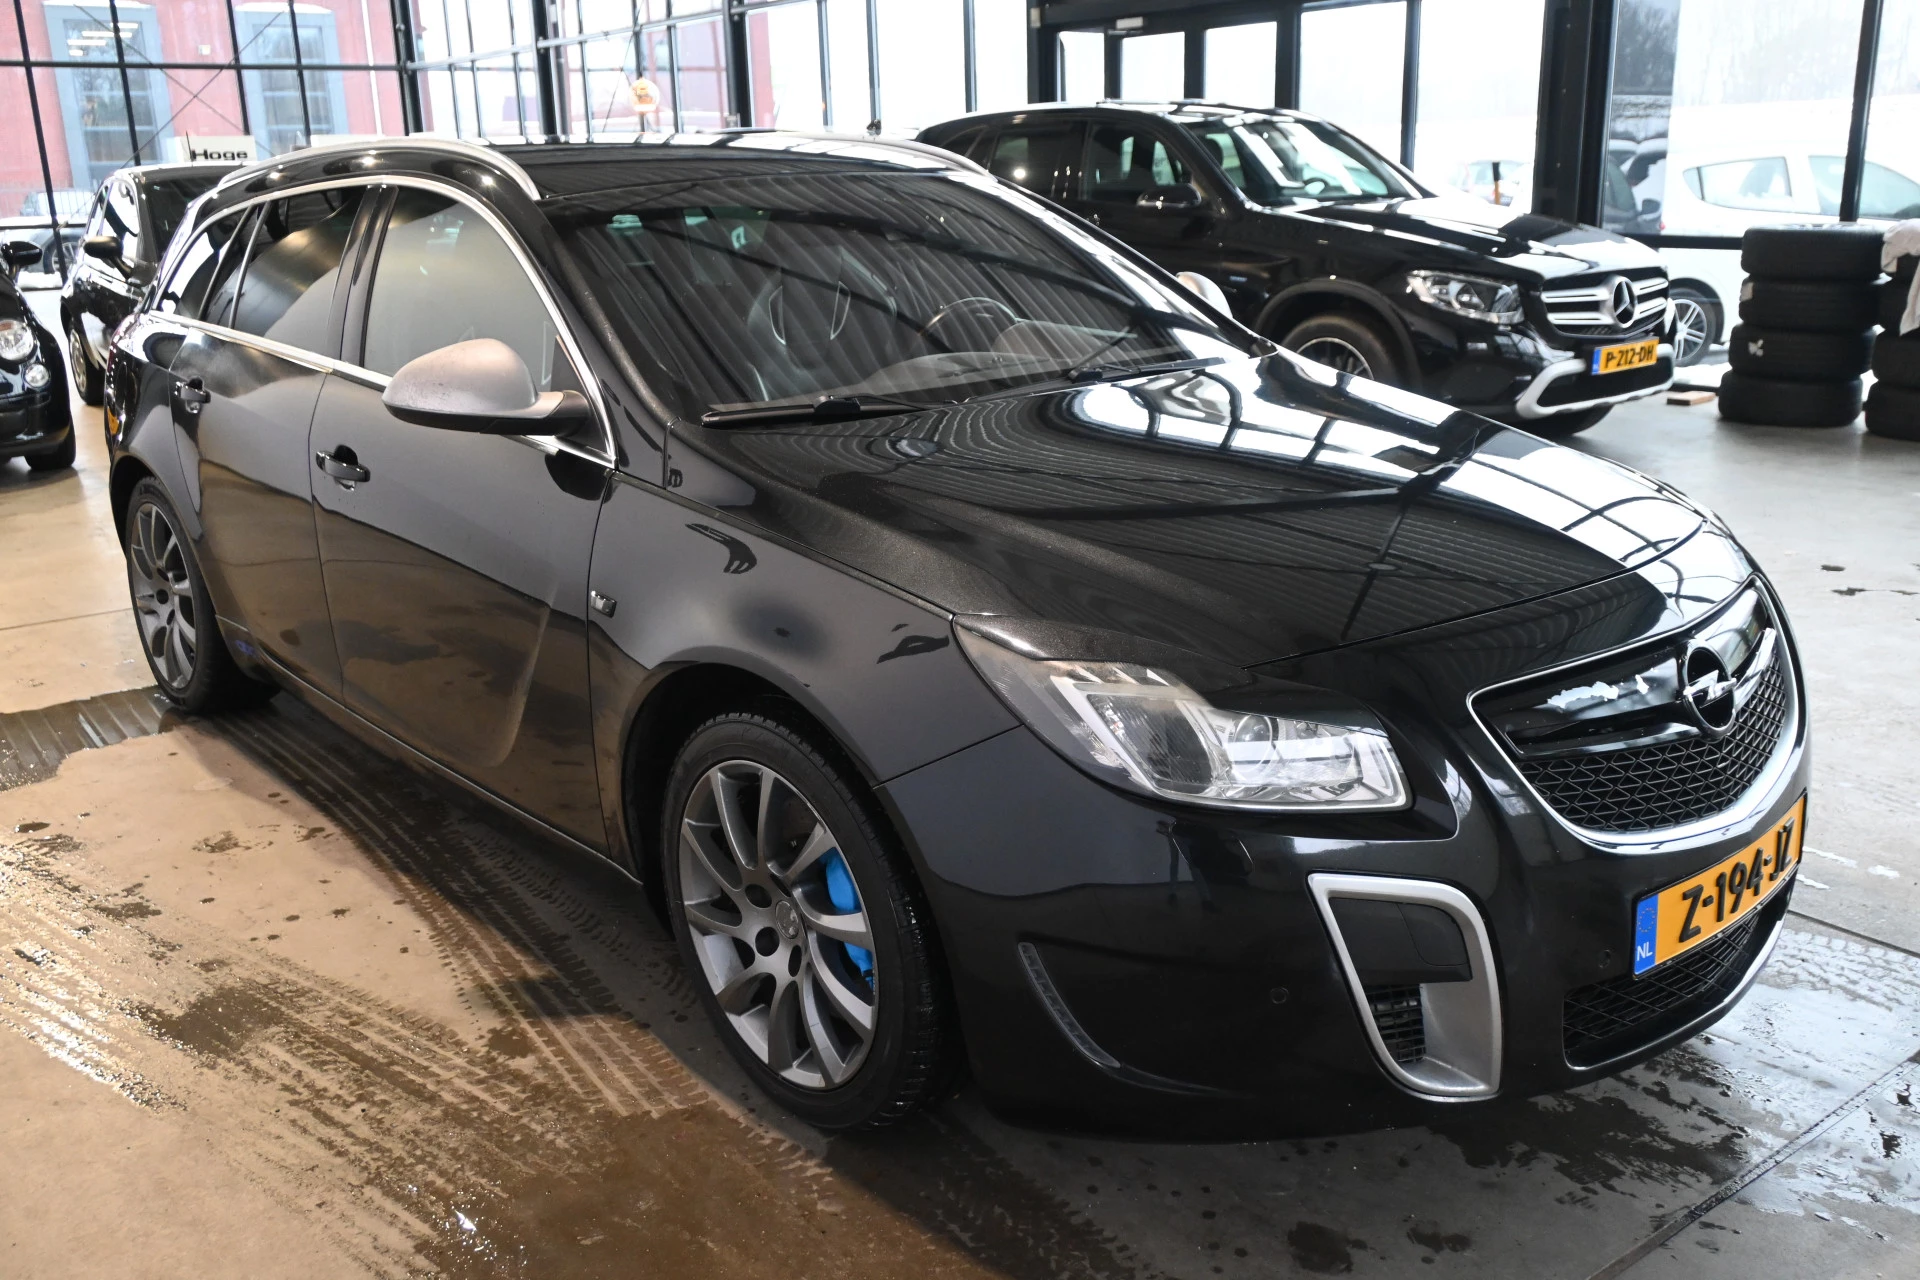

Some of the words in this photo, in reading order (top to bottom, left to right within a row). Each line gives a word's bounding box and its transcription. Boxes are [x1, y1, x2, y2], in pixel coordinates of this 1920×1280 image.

[1604, 344, 1654, 369] P-212-DH
[1679, 816, 1795, 943] Z-194-JZ
[1636, 941, 1653, 962] NL
